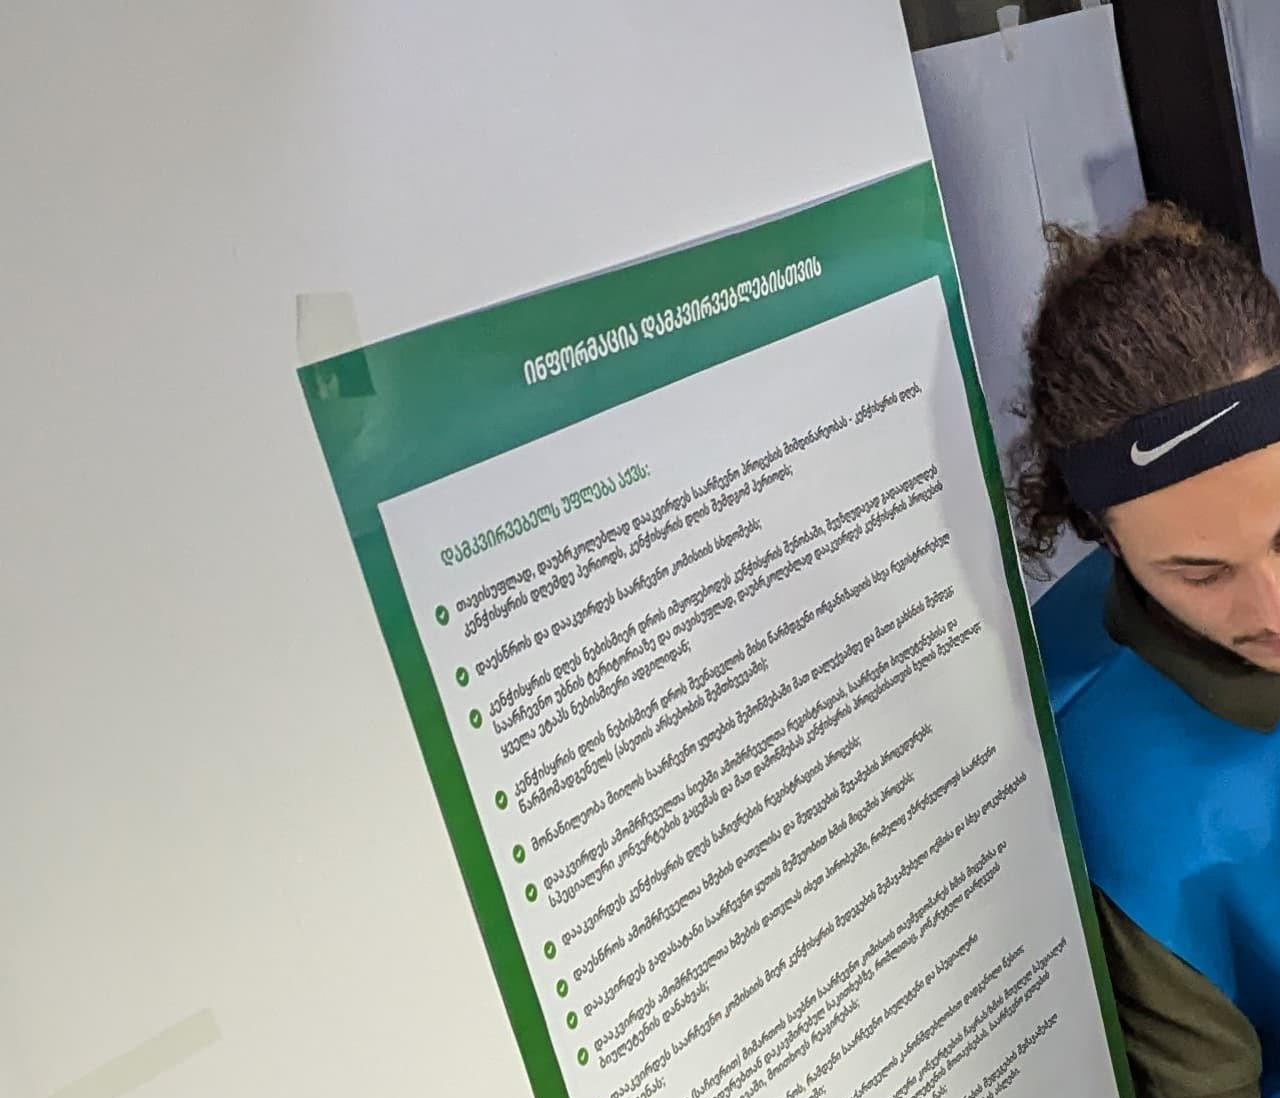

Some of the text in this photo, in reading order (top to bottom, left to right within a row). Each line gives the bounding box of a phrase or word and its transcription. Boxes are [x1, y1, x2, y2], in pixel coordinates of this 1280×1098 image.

[524, 257, 822, 385] ინფორმაცია დამკვირვებლებისთვის
[439, 463, 651, 567] დამკვირვებელს უფლება აქვს:
[464, 589, 529, 639] კენჭისყრის
[529, 571, 576, 603] დღემდე
[475, 633, 533, 677] დაესწროს
[533, 627, 550, 646] და
[488, 668, 552, 718] კენჭისყრის
[552, 651, 583, 681] დღეს
[492, 693, 554, 735] საარჩევნო
[553, 673, 586, 705] უბნის
[499, 727, 537, 760] ყველა
[537, 706, 570, 738] ეტაპს
[514, 746, 577, 798] კენჭისყრის
[577, 729, 607, 759] დღის
[517, 748, 614, 815] წარმომადგენელს
[530, 799, 607, 852] მონაწილეობა
[543, 837, 610, 891] დააკვირდეს
[547, 858, 616, 909] სპეციალური
[561, 892, 627, 947] დააკვირდეს
[572, 935, 626, 983] დაესწროს
[583, 961, 647, 1018] დააკვირდეს
[593, 996, 657, 1053] დააკვირდეს
[597, 1014, 661, 1070] ბიულეტენის
